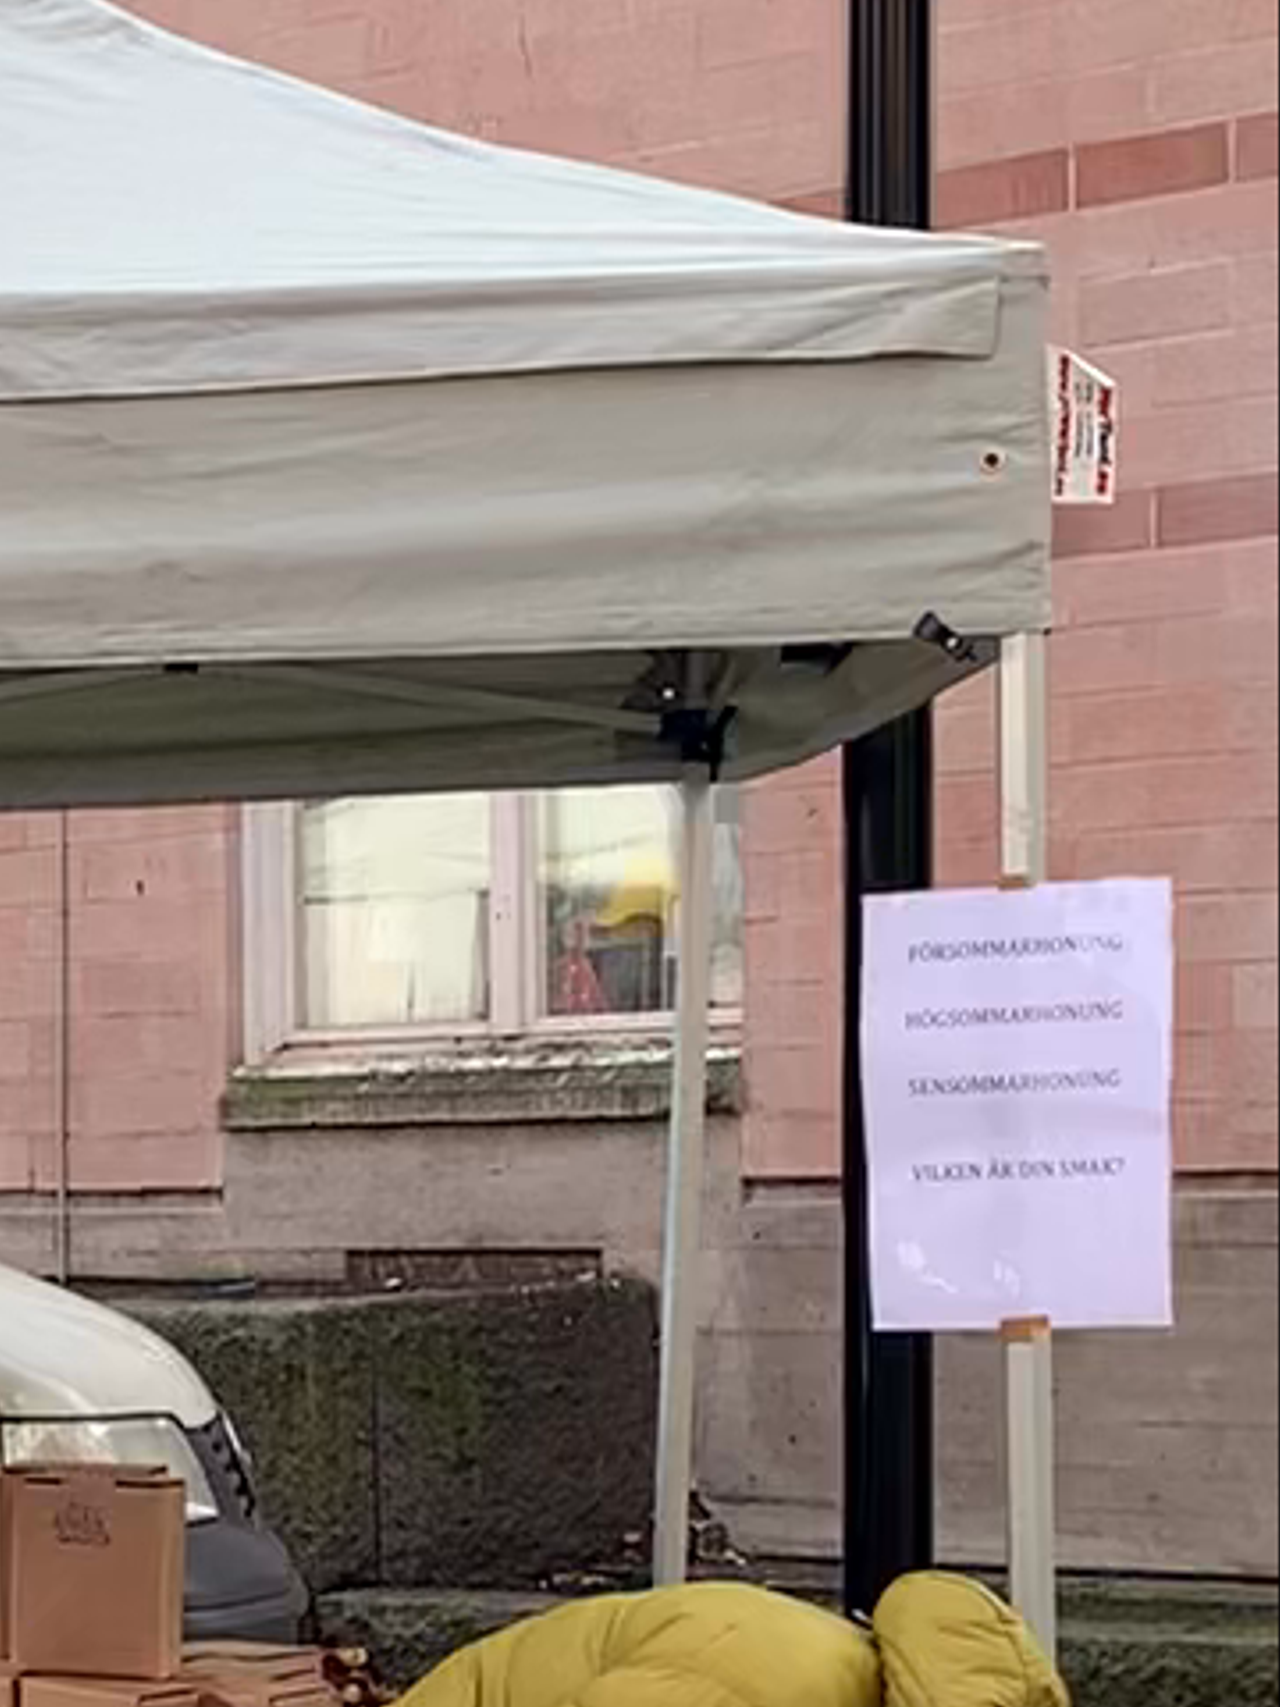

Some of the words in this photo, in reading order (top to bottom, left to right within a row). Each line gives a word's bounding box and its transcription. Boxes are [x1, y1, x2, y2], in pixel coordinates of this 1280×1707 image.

[905, 1001, 1123, 1028] HÖGSOMMARHONUNG
[908, 1069, 1121, 1095] SENSOMMARHONUNG
[912, 1161, 983, 1182] VILKEN
[987, 1156, 1014, 1180] ÄR
[1019, 1159, 1055, 1178] DIN
[1060, 1156, 1126, 1177] SMAK?
